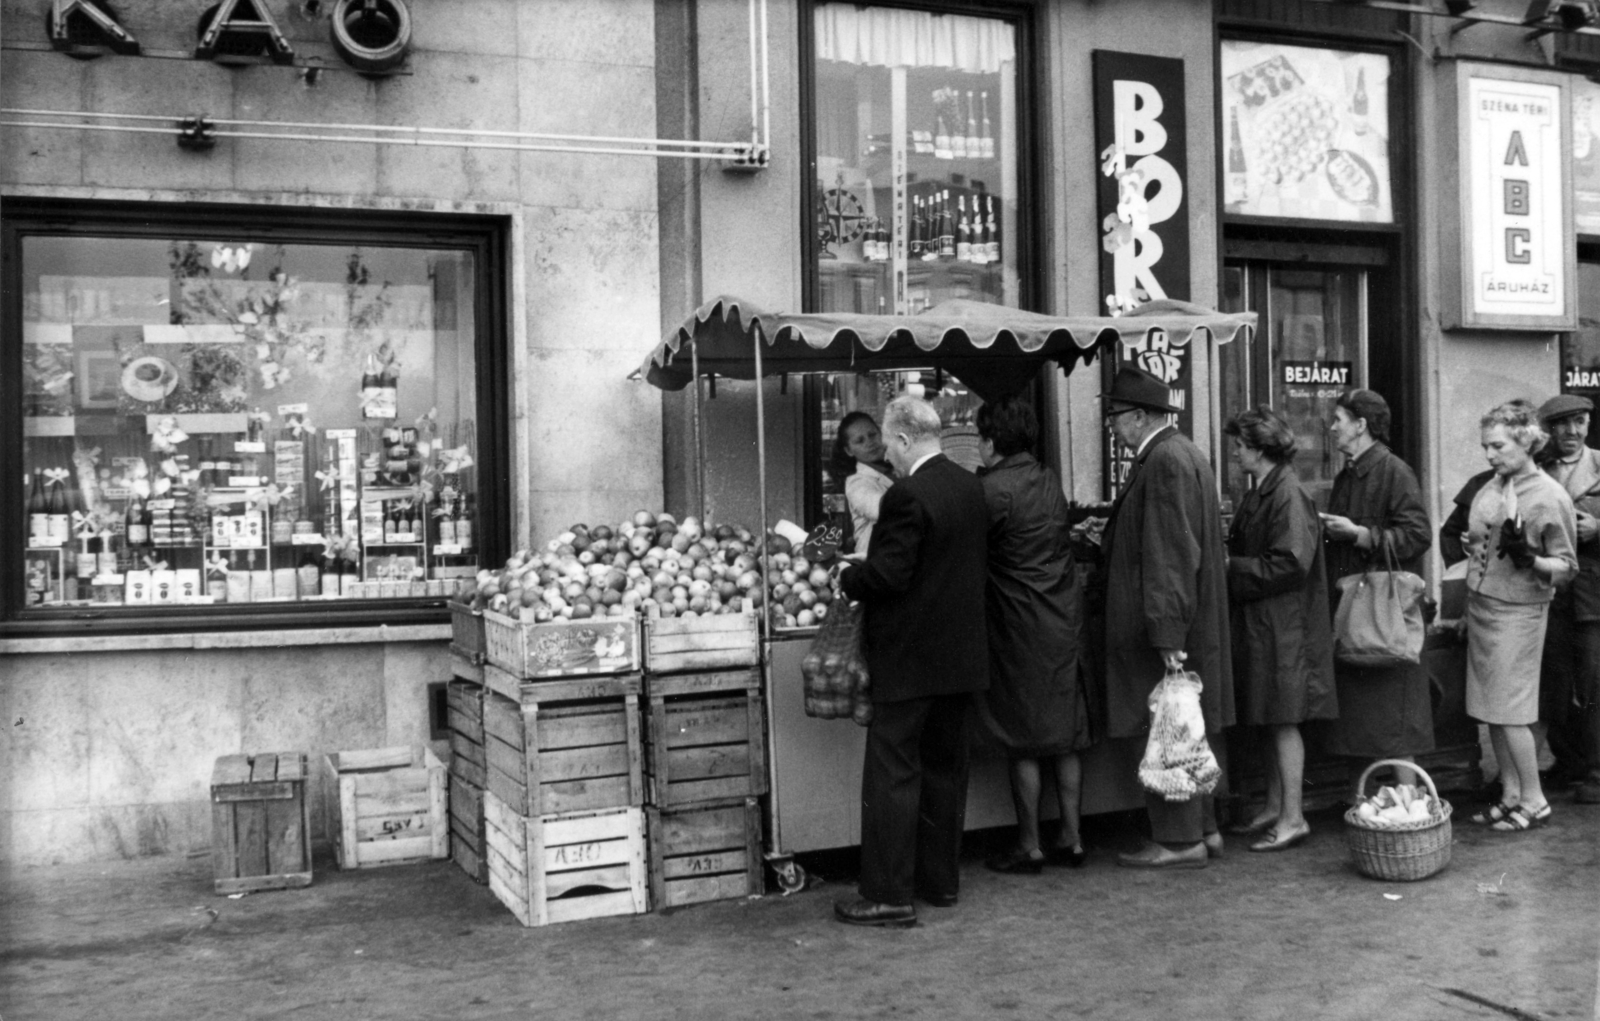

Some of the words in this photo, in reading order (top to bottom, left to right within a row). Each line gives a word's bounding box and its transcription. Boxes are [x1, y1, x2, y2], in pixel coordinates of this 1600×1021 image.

[1481, 98, 1519, 113] SZÉNA
[1523, 101, 1549, 116] TÉRI
[1112, 80, 1183, 312] BOR
[1504, 130, 1531, 265] ABC
[1486, 277, 1550, 294] ÁRUHÁZ
[1285, 361, 1348, 383] BEJÁRAT
[1565, 365, 1600, 387] JÁRA
